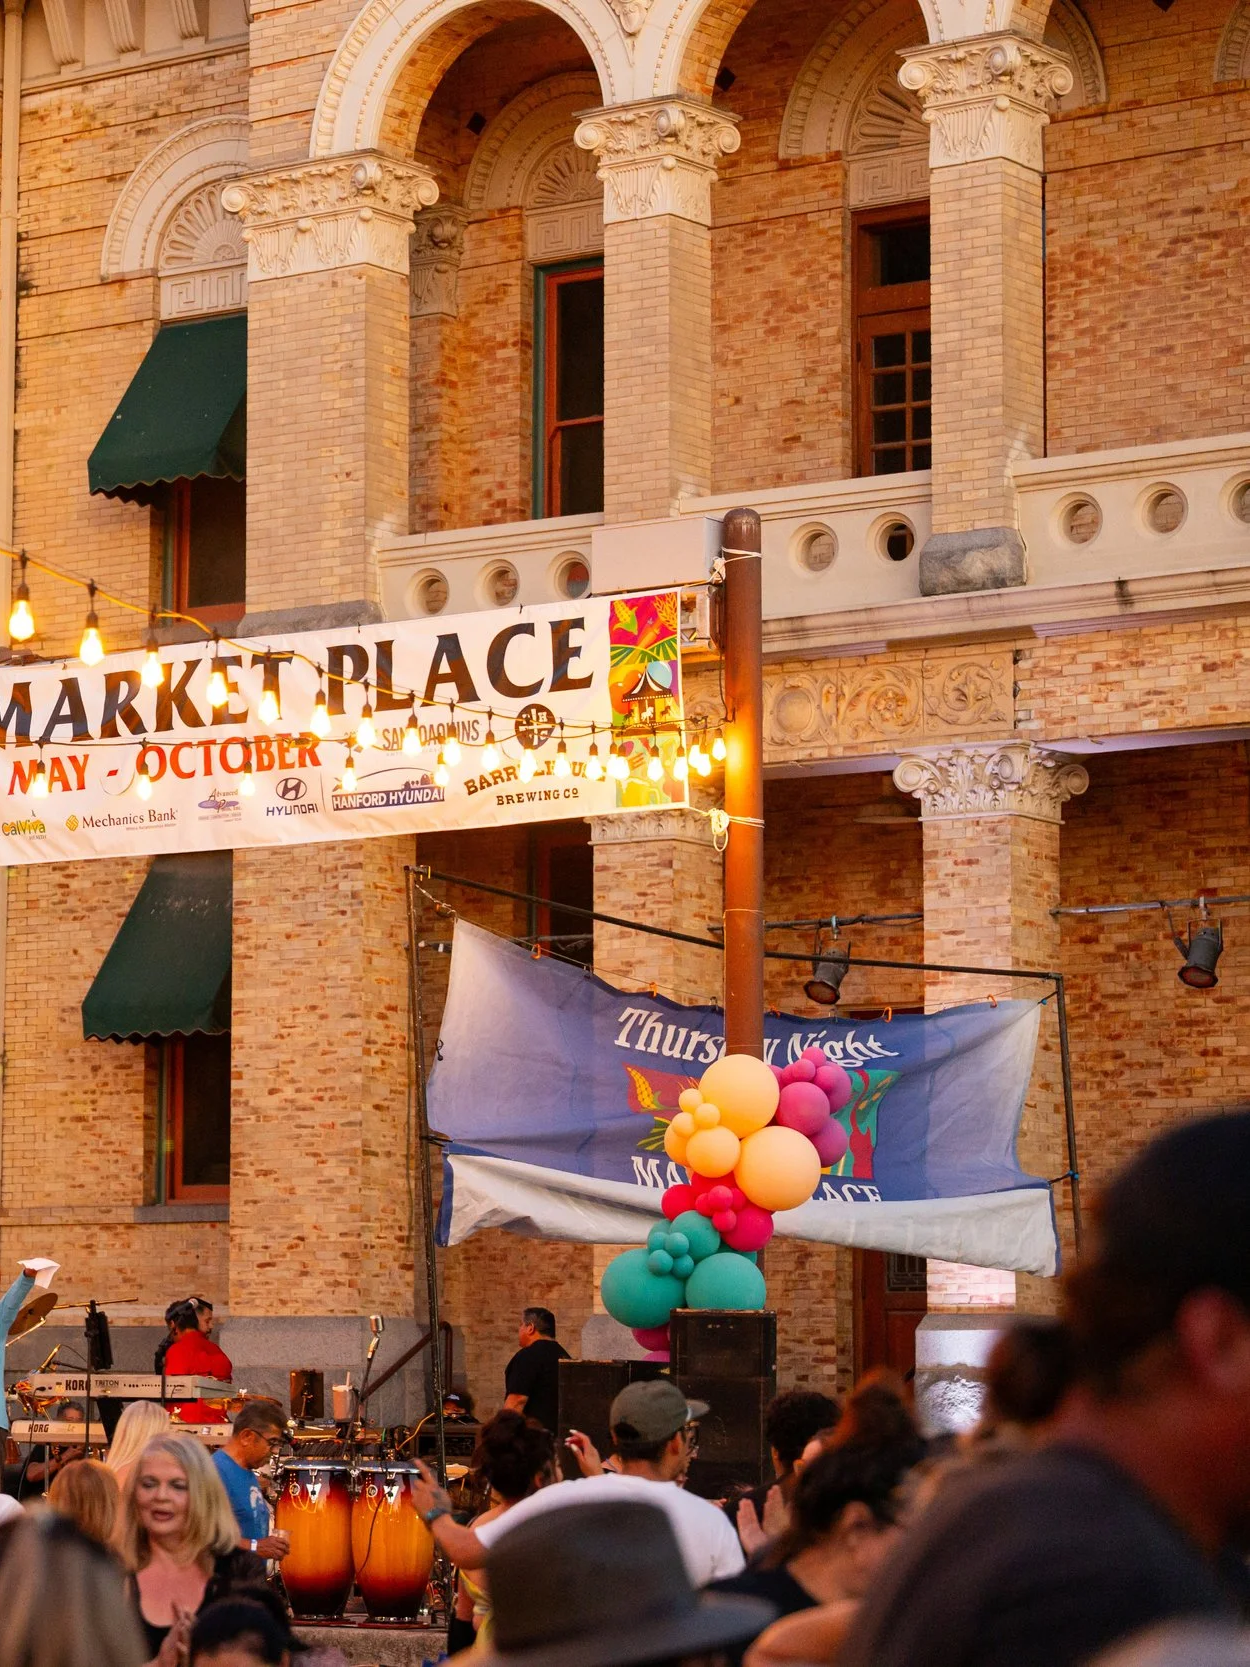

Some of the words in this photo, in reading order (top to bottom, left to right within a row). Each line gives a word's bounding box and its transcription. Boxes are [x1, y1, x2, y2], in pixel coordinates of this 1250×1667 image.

[326, 617, 594, 716] PLACE
[7, 754, 90, 796] MAY
[136, 732, 322, 782] OCTOBER
[332, 793, 387, 809] HANFORD
[389, 787, 444, 805] HYUNDAI
[496, 790, 560, 805] BREWING
[82, 814, 145, 829] Mechanics
[148, 808, 177, 822] Bank
[266, 804, 319, 816] HYUNDAI
[1, 819, 46, 837] CalViva
[27, 1424, 50, 1433] KORG
